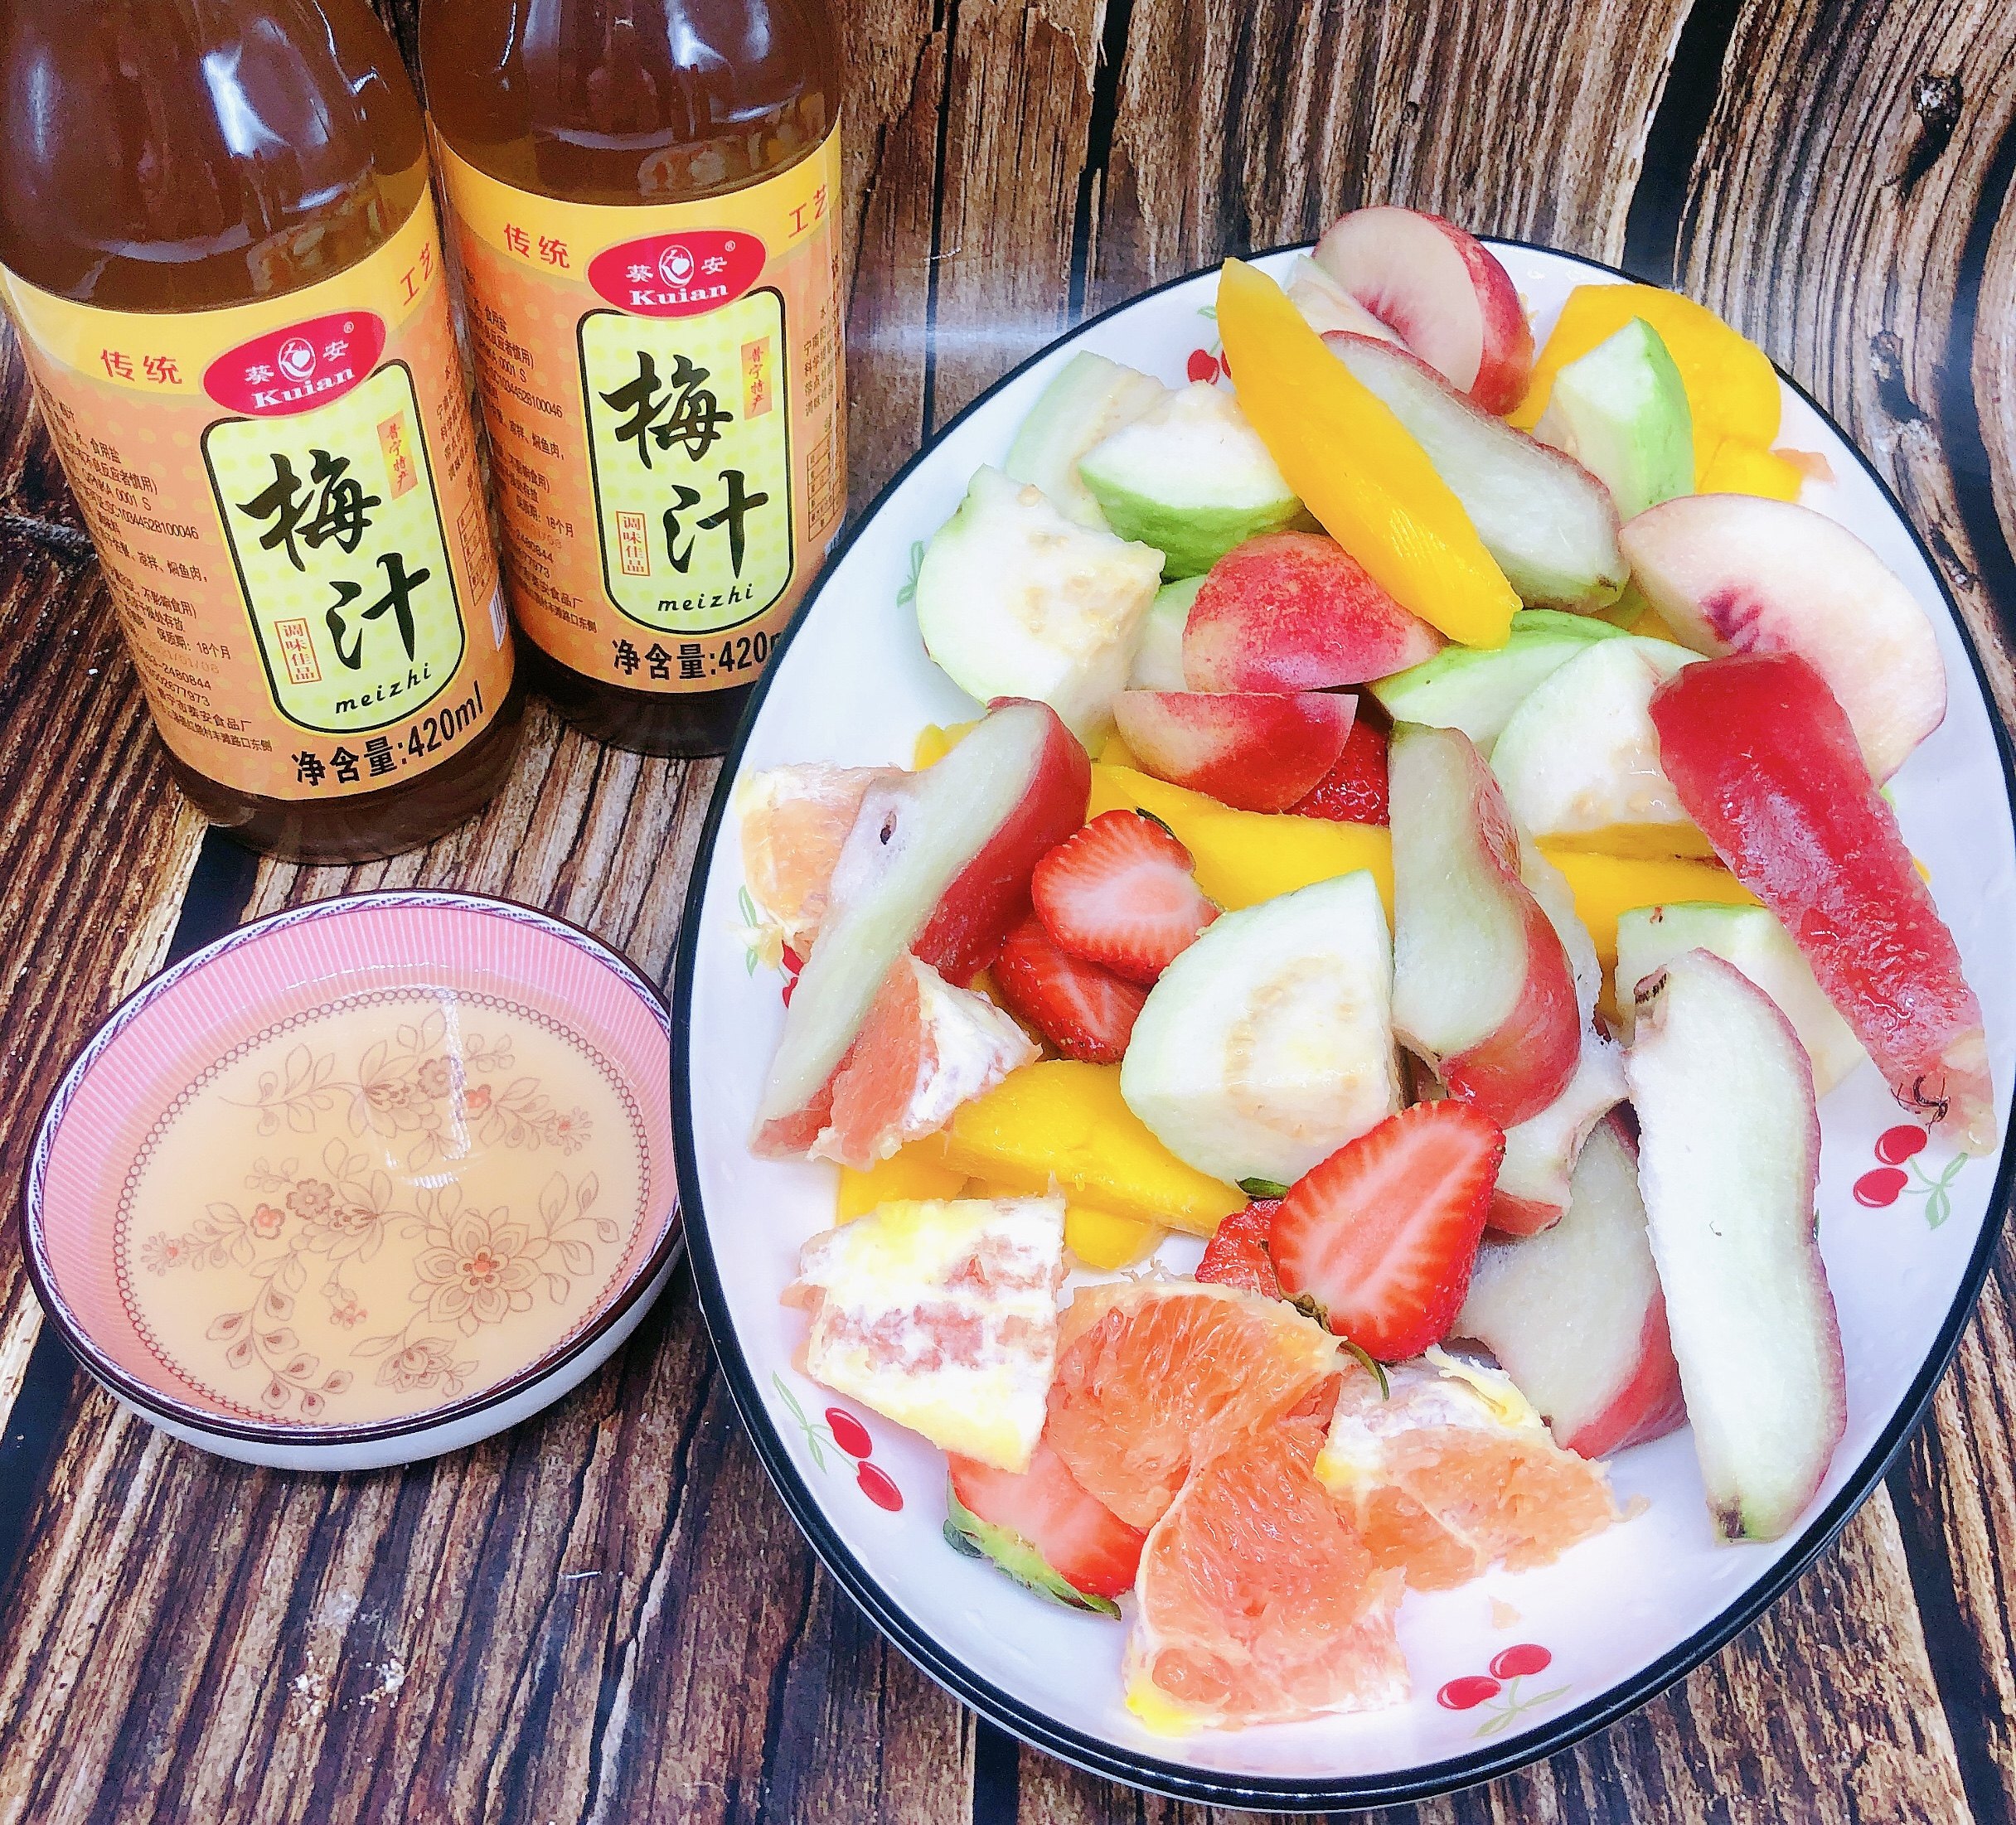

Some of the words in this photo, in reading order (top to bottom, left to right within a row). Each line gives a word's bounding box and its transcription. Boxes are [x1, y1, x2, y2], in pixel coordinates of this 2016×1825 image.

[788, 184, 827, 239] 工艺
[503, 223, 571, 269] 传统
[400, 240, 434, 306] 工艺
[629, 283, 729, 307] Kuian
[100, 348, 183, 385] 传统
[251, 368, 356, 409] Kuian
[598, 351, 769, 579] 梅汁
[235, 448, 431, 670] 梅汁
[657, 583, 754, 612] meizhi
[335, 662, 432, 714] meizhi
[291, 679, 484, 787] 净含量:420ml
